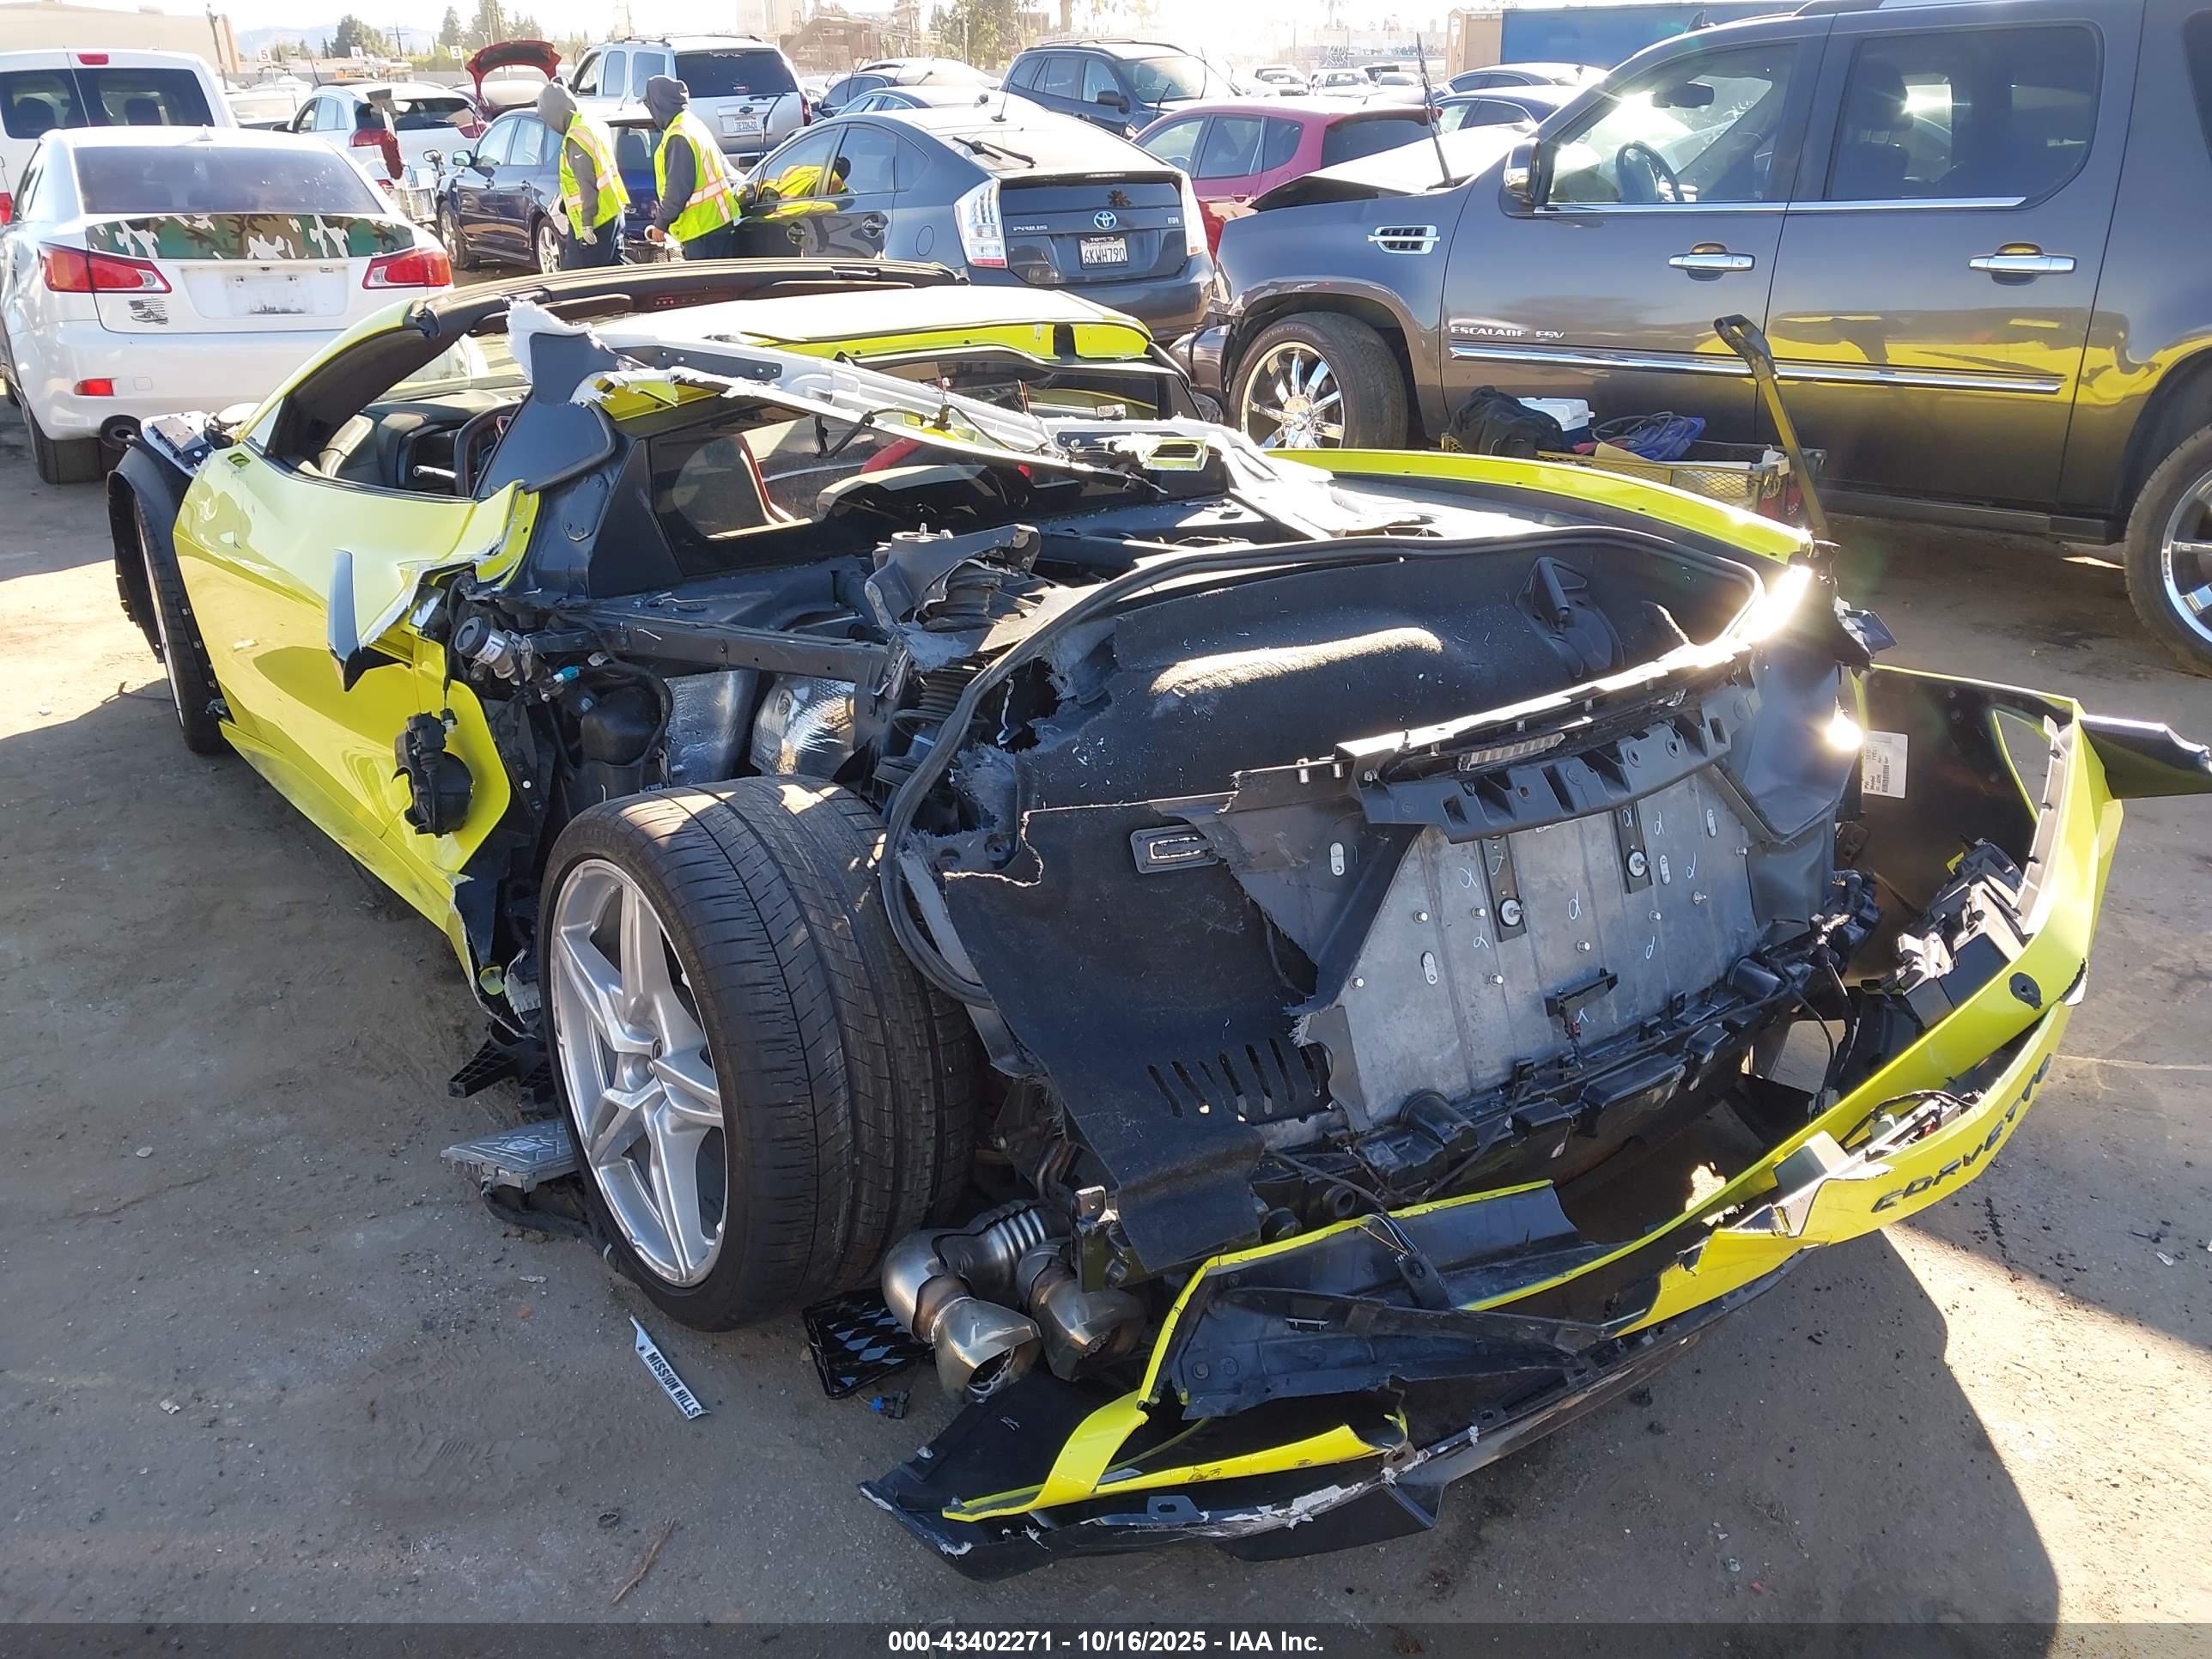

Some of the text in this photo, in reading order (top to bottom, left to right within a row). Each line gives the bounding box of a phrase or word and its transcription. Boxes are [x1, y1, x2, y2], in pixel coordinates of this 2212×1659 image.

[453, 47, 460, 57] 3
[1084, 247, 1126, 264] 6KWH790
[1450, 325, 1565, 338] ESCALADE ESV
[1870, 1053, 2053, 1212] CORVETTE
[645, 1352, 700, 1417] MISSION HILLS
